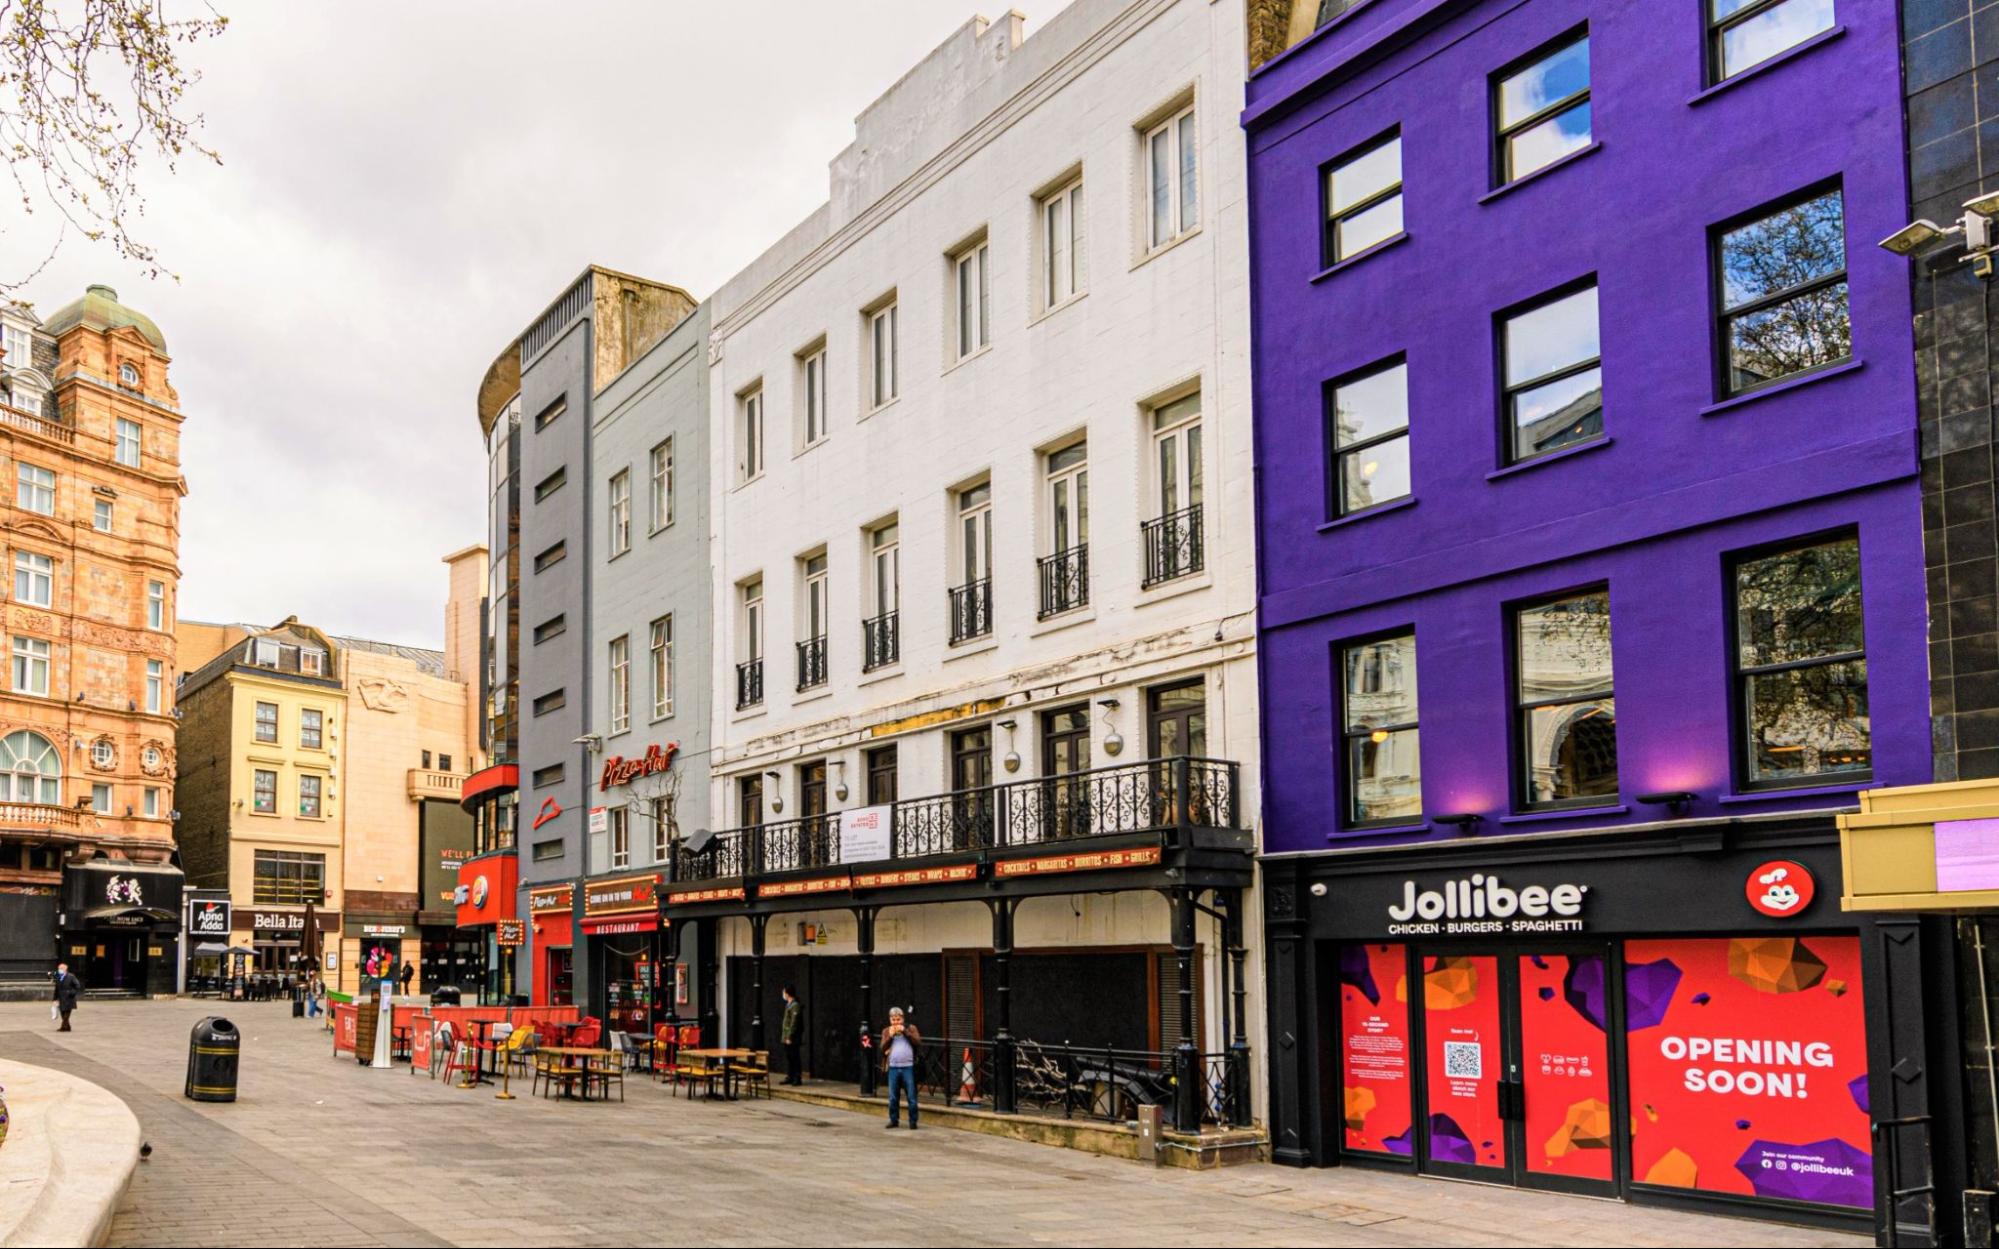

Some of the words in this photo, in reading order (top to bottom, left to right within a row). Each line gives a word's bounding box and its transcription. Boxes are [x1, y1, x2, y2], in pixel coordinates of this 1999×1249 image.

[600, 755, 645, 792] Pizza
[641, 743, 679, 777] Hut
[1388, 873, 1582, 921] Jollibee
[198, 911, 224, 922] Apna
[254, 914, 286, 928] Bella
[200, 921, 224, 930] Adda
[596, 922, 640, 935] RESTAURANT
[1388, 923, 1439, 935] CHICKEN
[1447, 921, 1503, 934] BURGERS
[1512, 919, 1583, 932] SPAGHETTI
[1661, 1036, 1834, 1068] OPENING
[1684, 1068, 1808, 1099] SOON!
[1761, 1151, 1775, 1159] Join
[1788, 1153, 1825, 1164] community
[1791, 1162, 1855, 1177] @jollibeeuk
